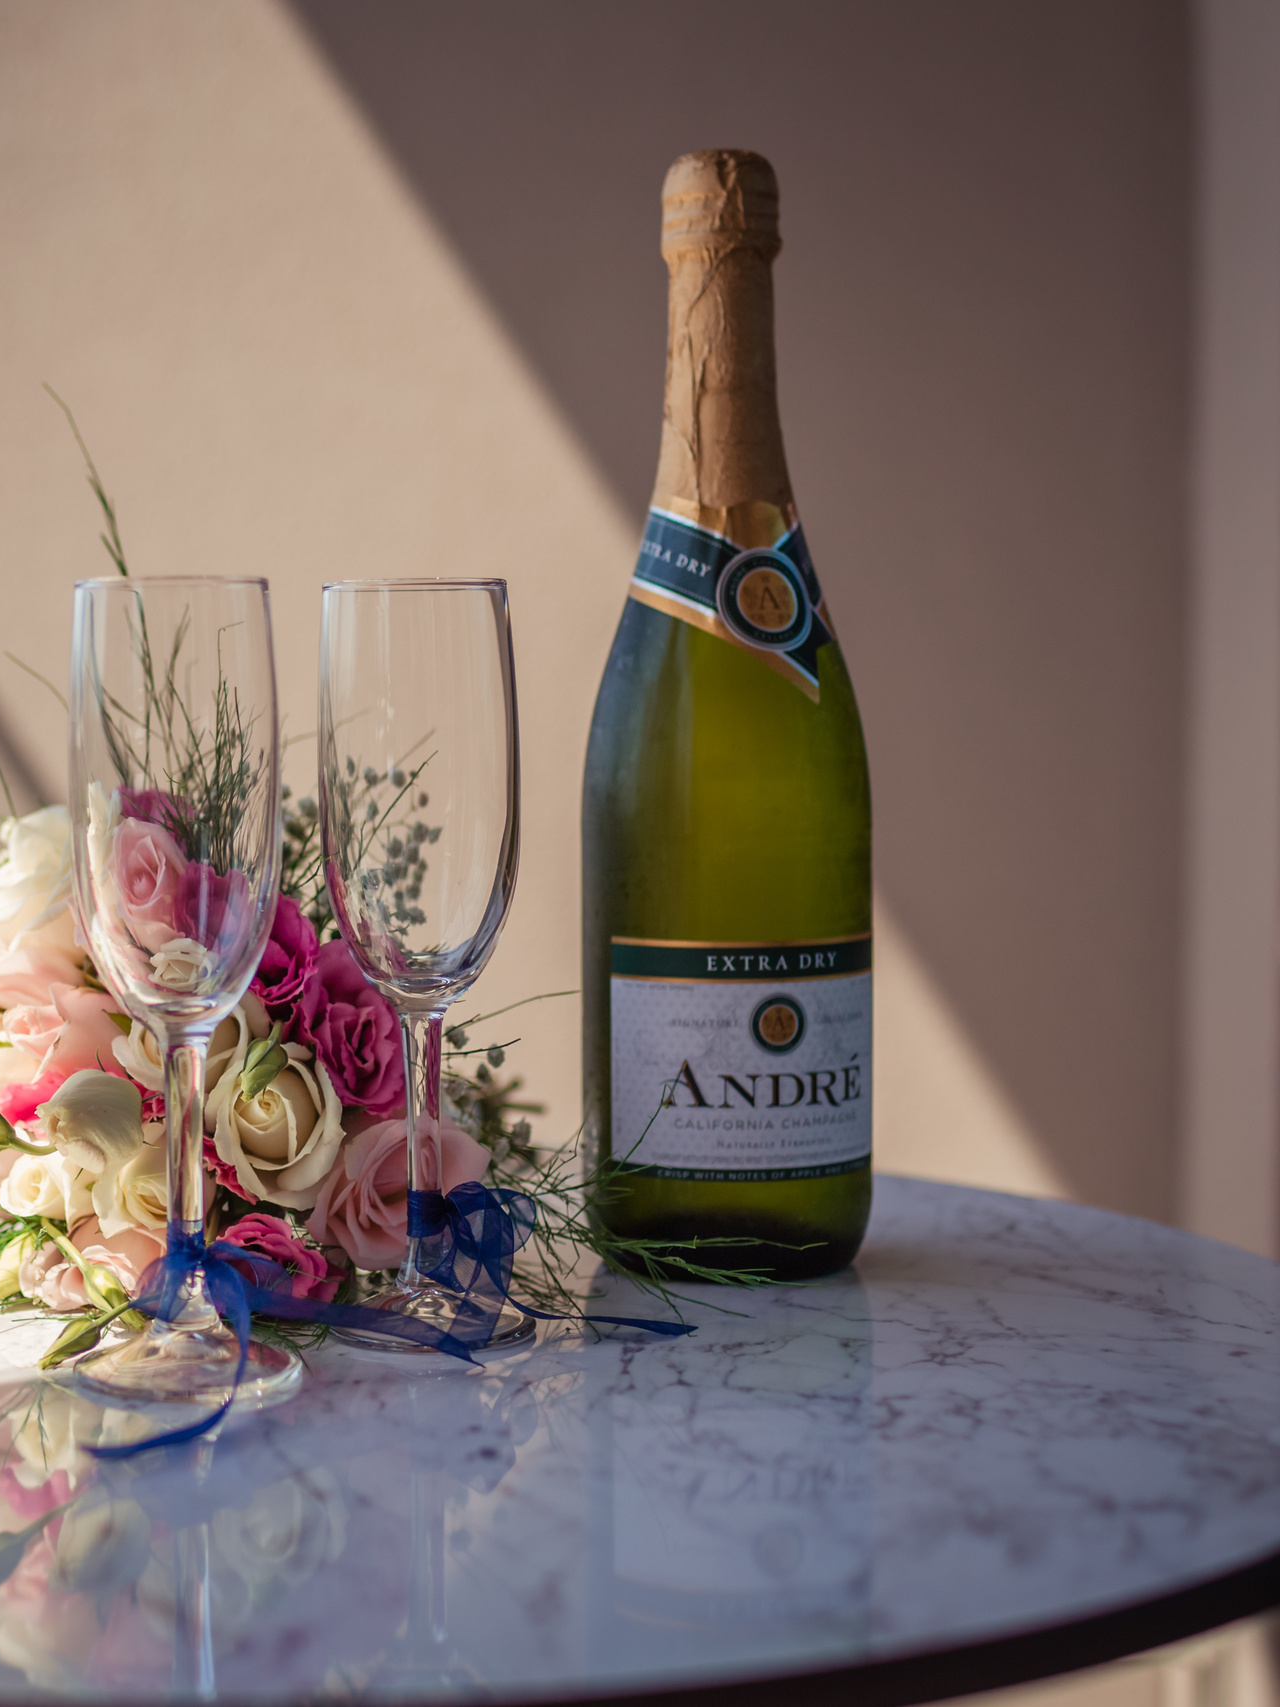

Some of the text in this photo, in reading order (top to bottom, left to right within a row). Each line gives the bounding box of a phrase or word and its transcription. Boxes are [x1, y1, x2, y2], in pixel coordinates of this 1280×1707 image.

[676, 553, 712, 577] DRY
[759, 585, 781, 610] A
[706, 952, 838, 972] EXTRA DRY
[660, 1053, 862, 1108] ANDRÉ
[674, 1111, 858, 1131] CALIFORNIA CHAMPAGNE
[657, 1168, 690, 1179] CRISP
[694, 1170, 724, 1180] WITH
[728, 1171, 766, 1181] NOTES
[771, 1171, 786, 1180] OF
[790, 1169, 821, 1179] APPLE
